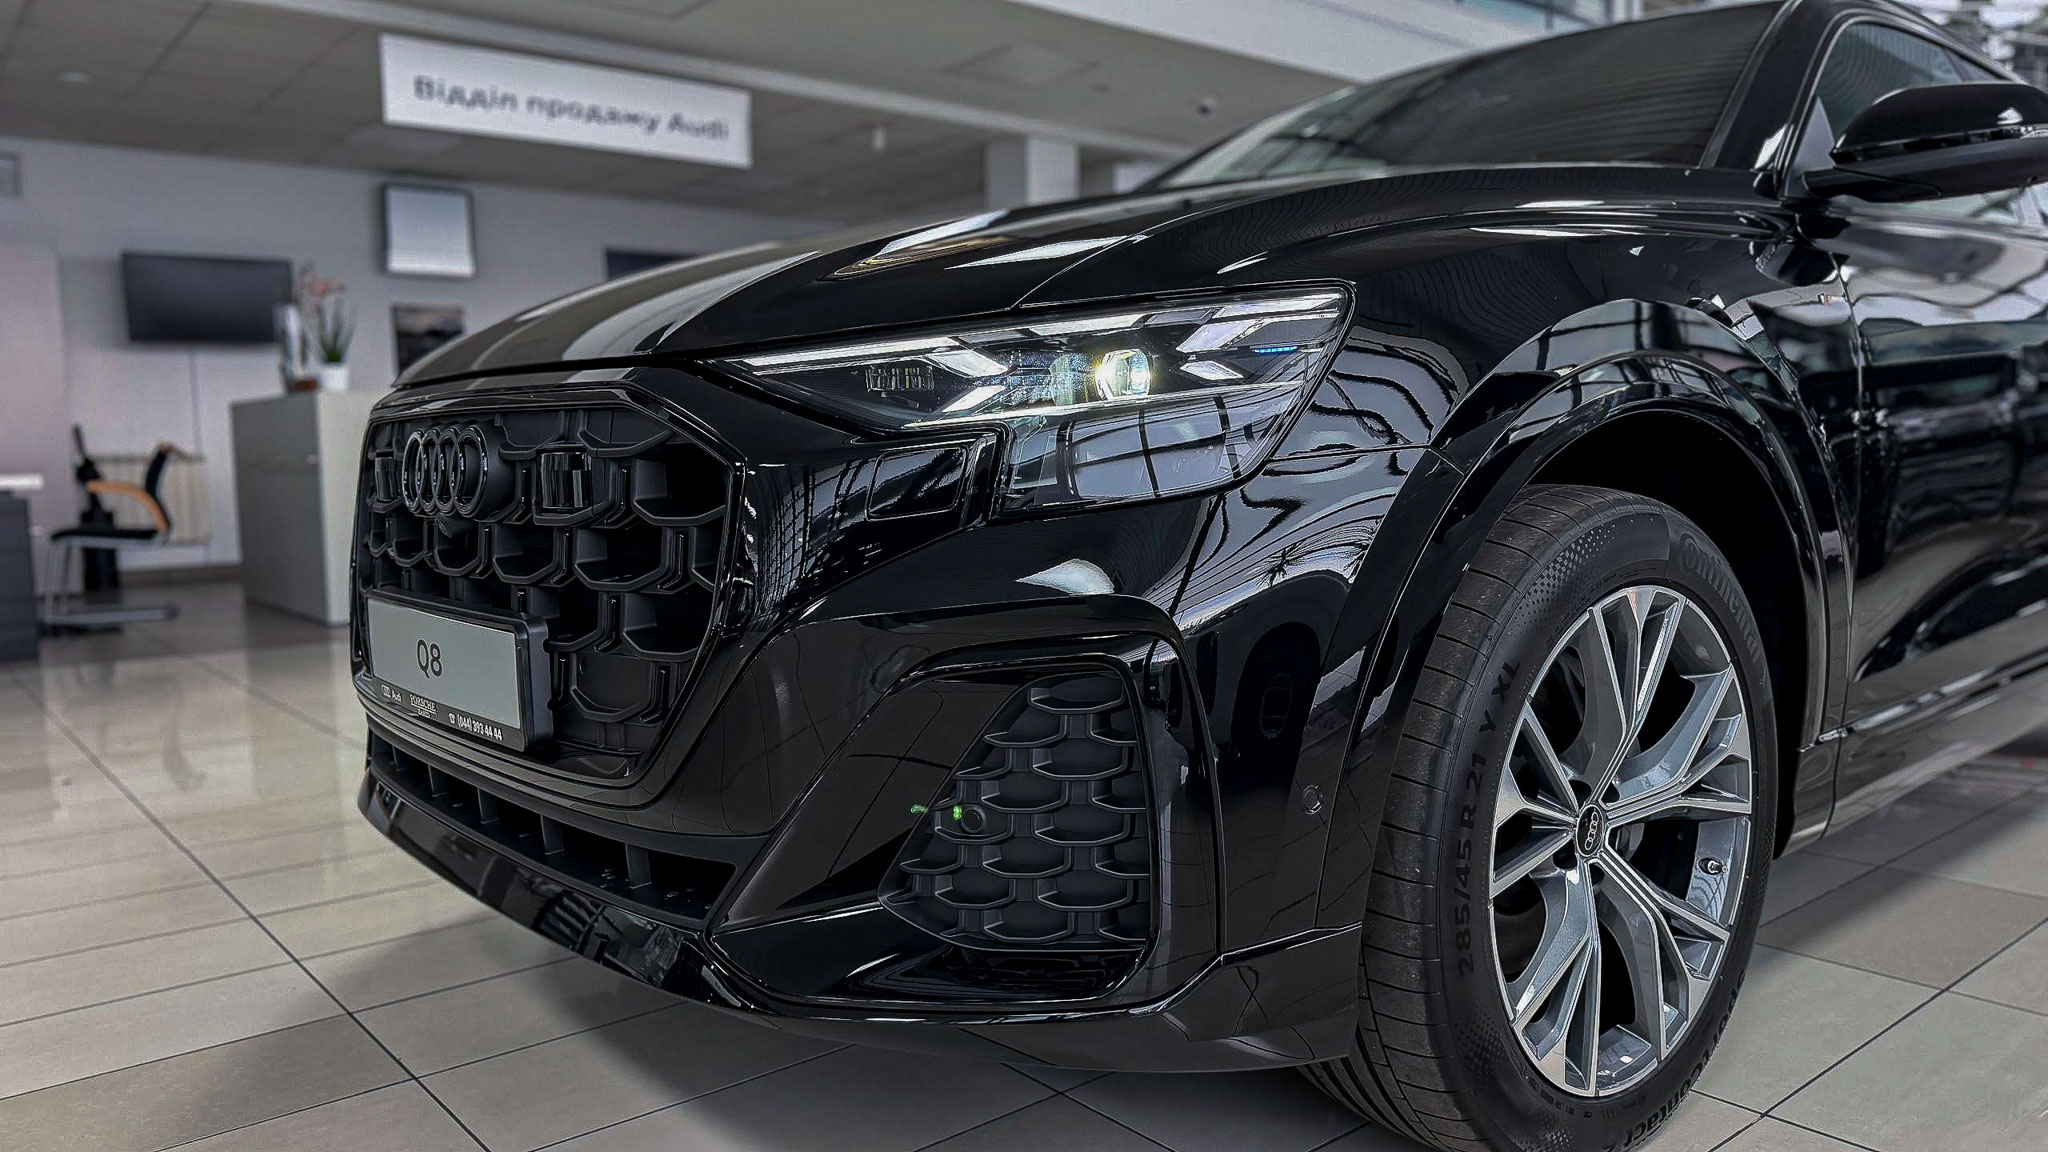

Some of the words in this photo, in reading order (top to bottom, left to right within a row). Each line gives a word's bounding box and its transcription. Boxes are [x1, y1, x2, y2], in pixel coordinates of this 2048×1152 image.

[526, 96, 661, 136] продажу
[667, 112, 729, 140] Audi
[416, 639, 443, 678] Q8
[1490, 661, 1521, 703] XL
[457, 713, 472, 732] (044)
[472, 720, 485, 735] 393
[484, 724, 493, 738] 44
[493, 727, 503, 741] 44
[1478, 708, 1496, 733] Y
[1466, 751, 1486, 795] 21
[1460, 803, 1477, 830] R
[1454, 838, 1475, 977] 285/45
